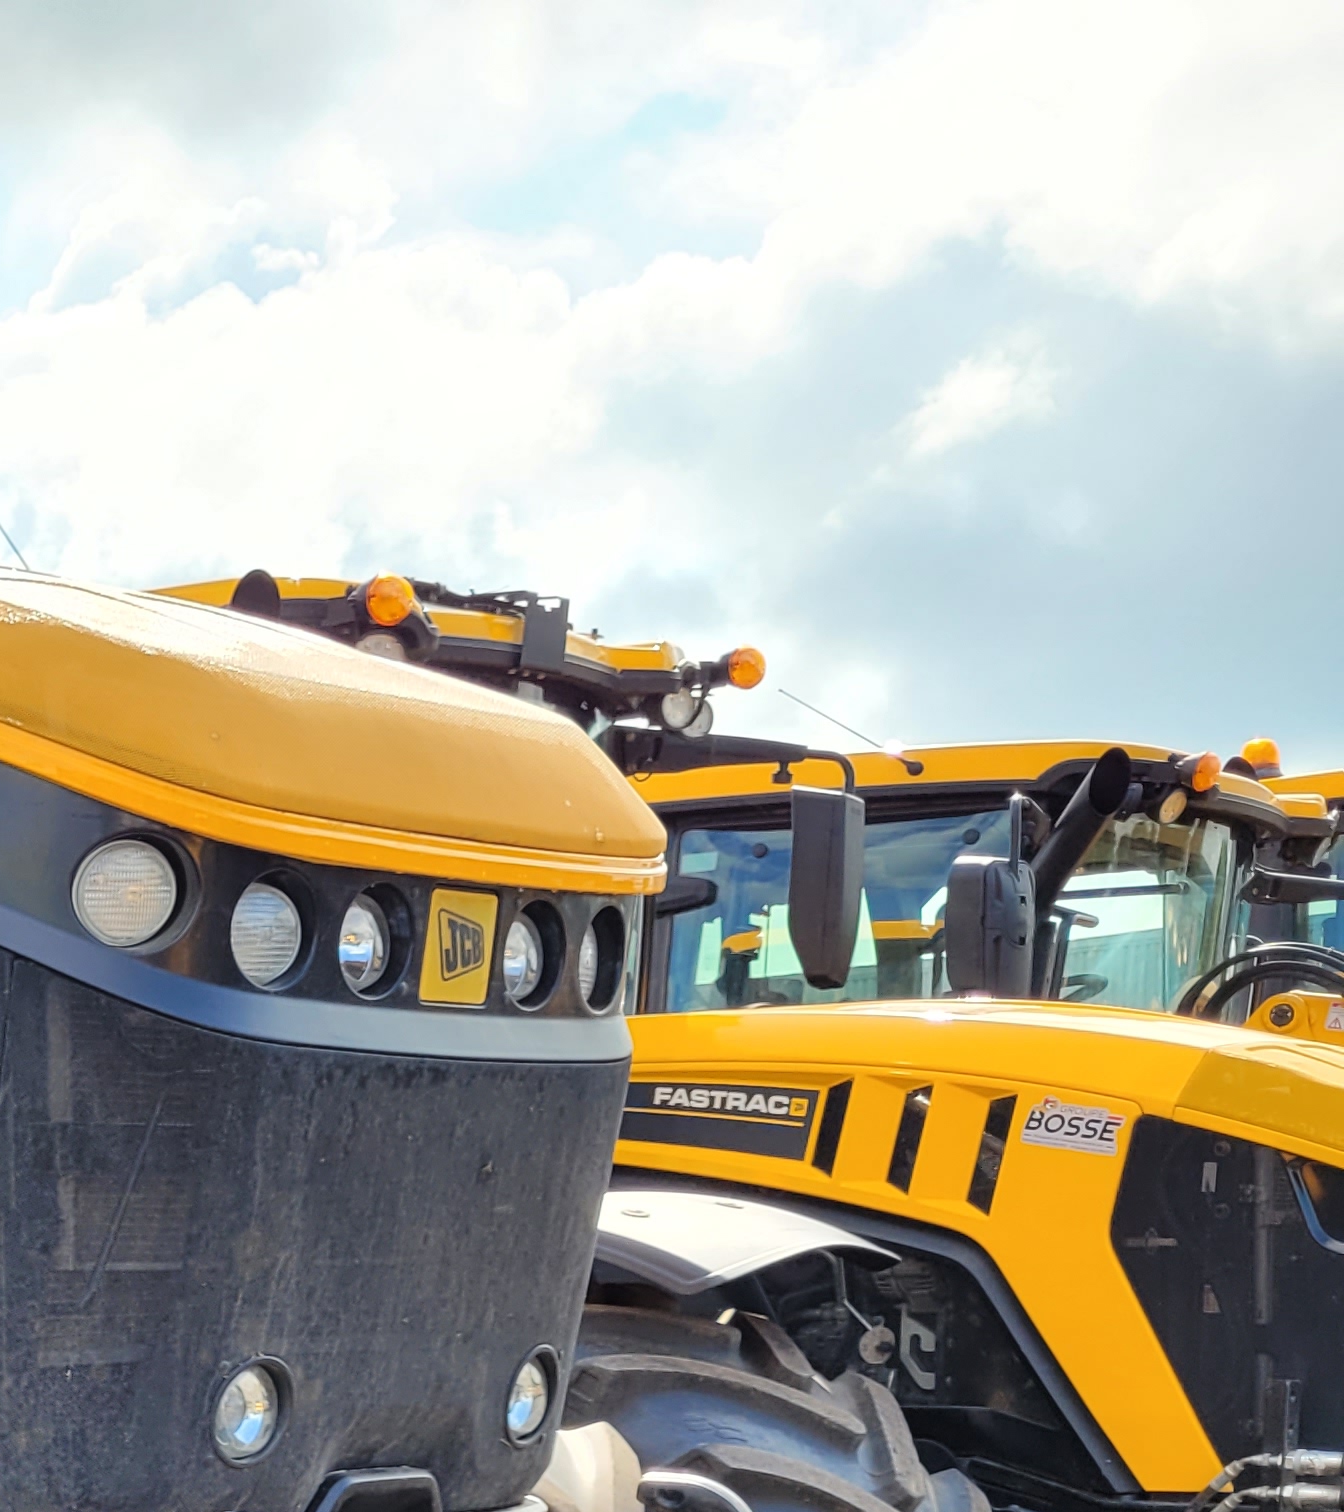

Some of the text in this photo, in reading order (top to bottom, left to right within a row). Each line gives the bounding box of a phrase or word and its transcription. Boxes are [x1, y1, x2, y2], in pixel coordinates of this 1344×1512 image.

[445, 917, 482, 974] JCB
[652, 1086, 790, 1115] FASTRAC
[1024, 1110, 1123, 1142] BOSSE
